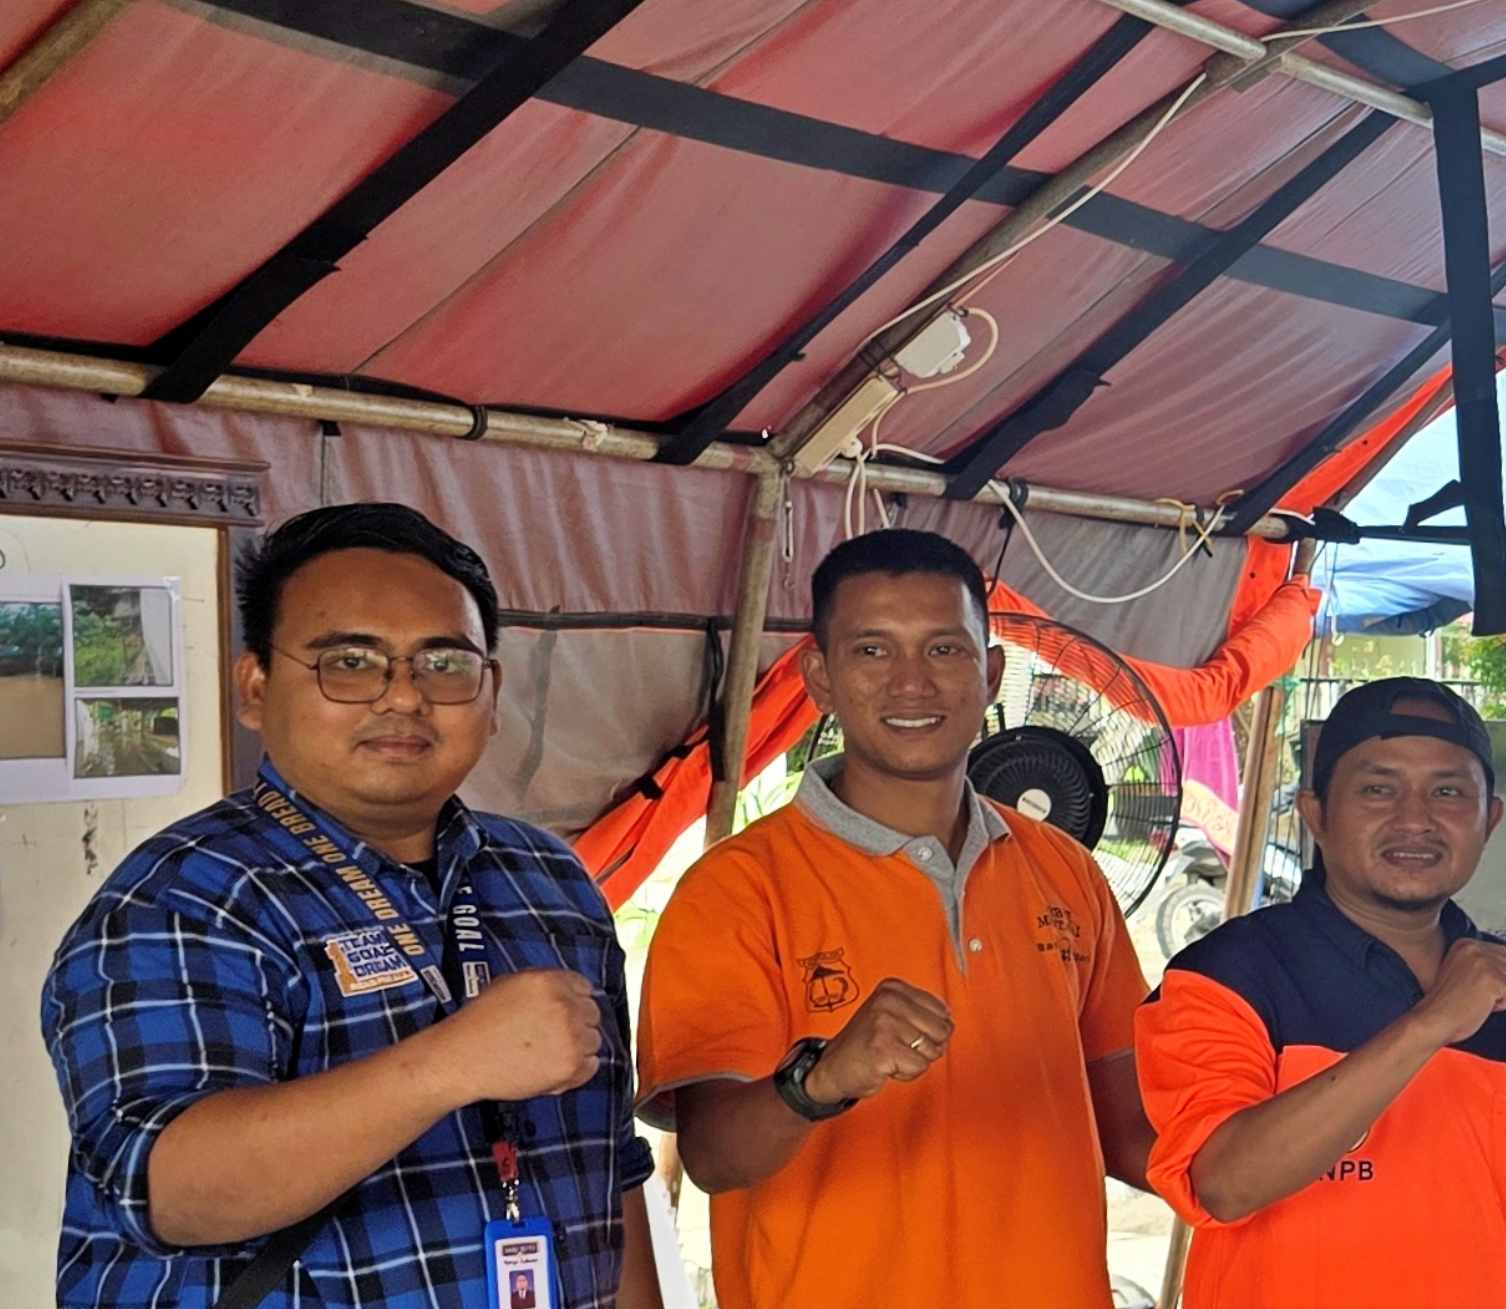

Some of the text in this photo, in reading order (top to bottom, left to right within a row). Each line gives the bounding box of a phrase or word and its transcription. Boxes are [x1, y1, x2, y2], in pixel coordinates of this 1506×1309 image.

[304, 835, 347, 863] ONE
[336, 866, 399, 920] DREAM
[389, 923, 426, 956] ONE
[453, 904, 485, 951] GOAL
[340, 931, 388, 950] TEAM
[348, 945, 394, 963] GOAL
[353, 957, 408, 977] DREAM
[1320, 1160, 1374, 1181] NPB
